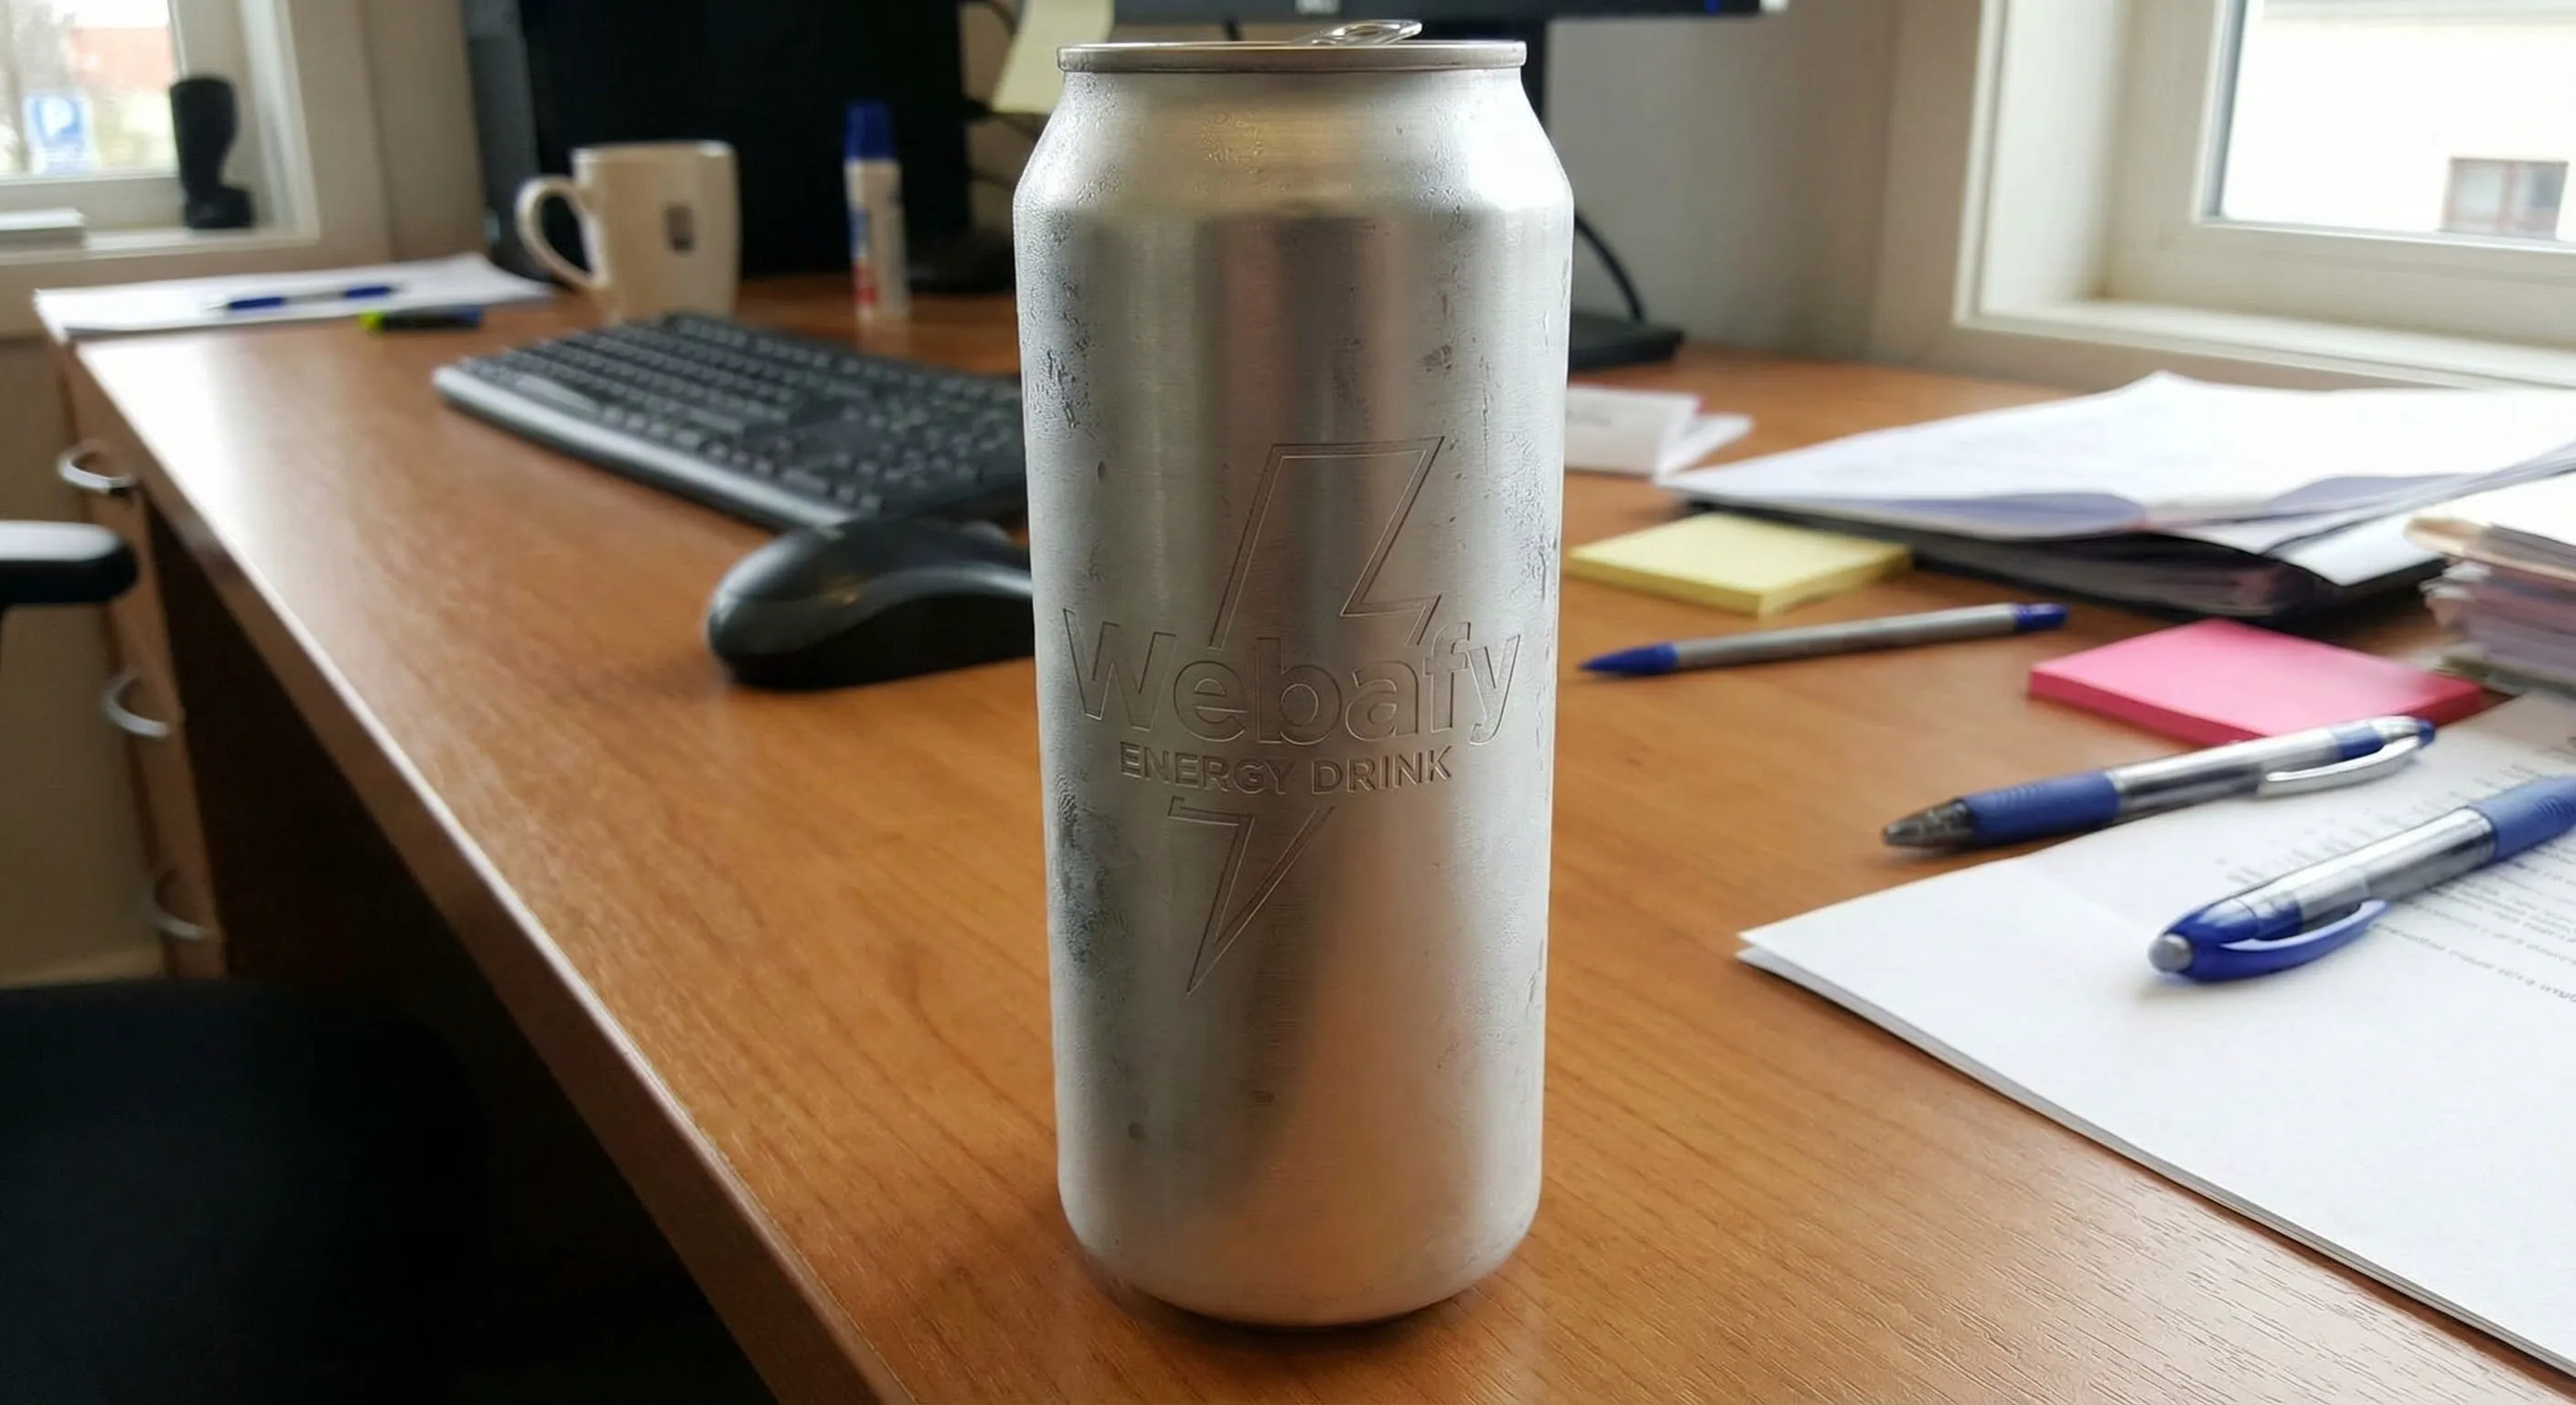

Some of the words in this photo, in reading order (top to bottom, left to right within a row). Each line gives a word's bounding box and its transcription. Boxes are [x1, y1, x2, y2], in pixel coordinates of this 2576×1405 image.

[1063, 607, 1520, 745] Webafy
[1120, 741, 1296, 795] ENERGY
[1311, 745, 1453, 795] DRINK
